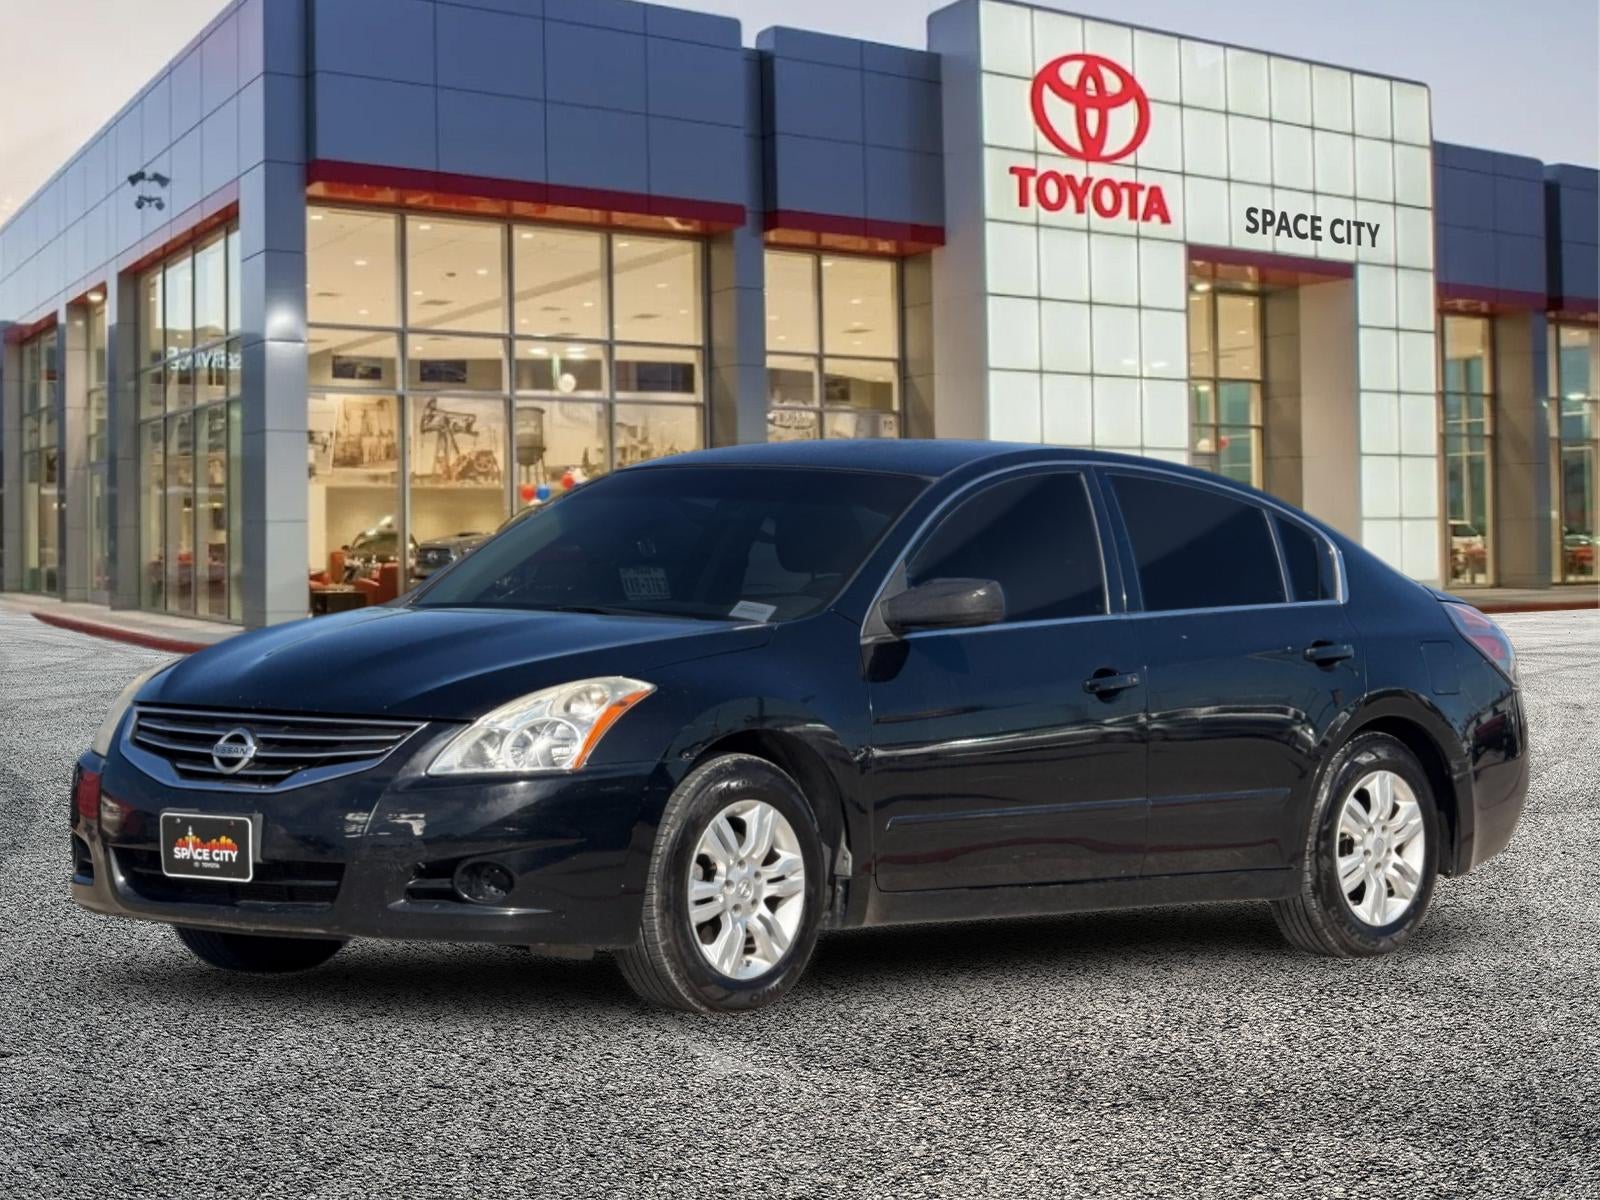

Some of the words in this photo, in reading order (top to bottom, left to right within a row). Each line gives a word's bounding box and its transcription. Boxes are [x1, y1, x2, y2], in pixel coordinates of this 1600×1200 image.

[1009, 166, 1171, 224] TOYOTA
[1245, 206, 1322, 241] SPACE
[1329, 219, 1381, 248] CITY
[215, 745, 248, 755] NISSAN
[173, 846, 210, 861] SPACE
[212, 849, 238, 863] CITY
